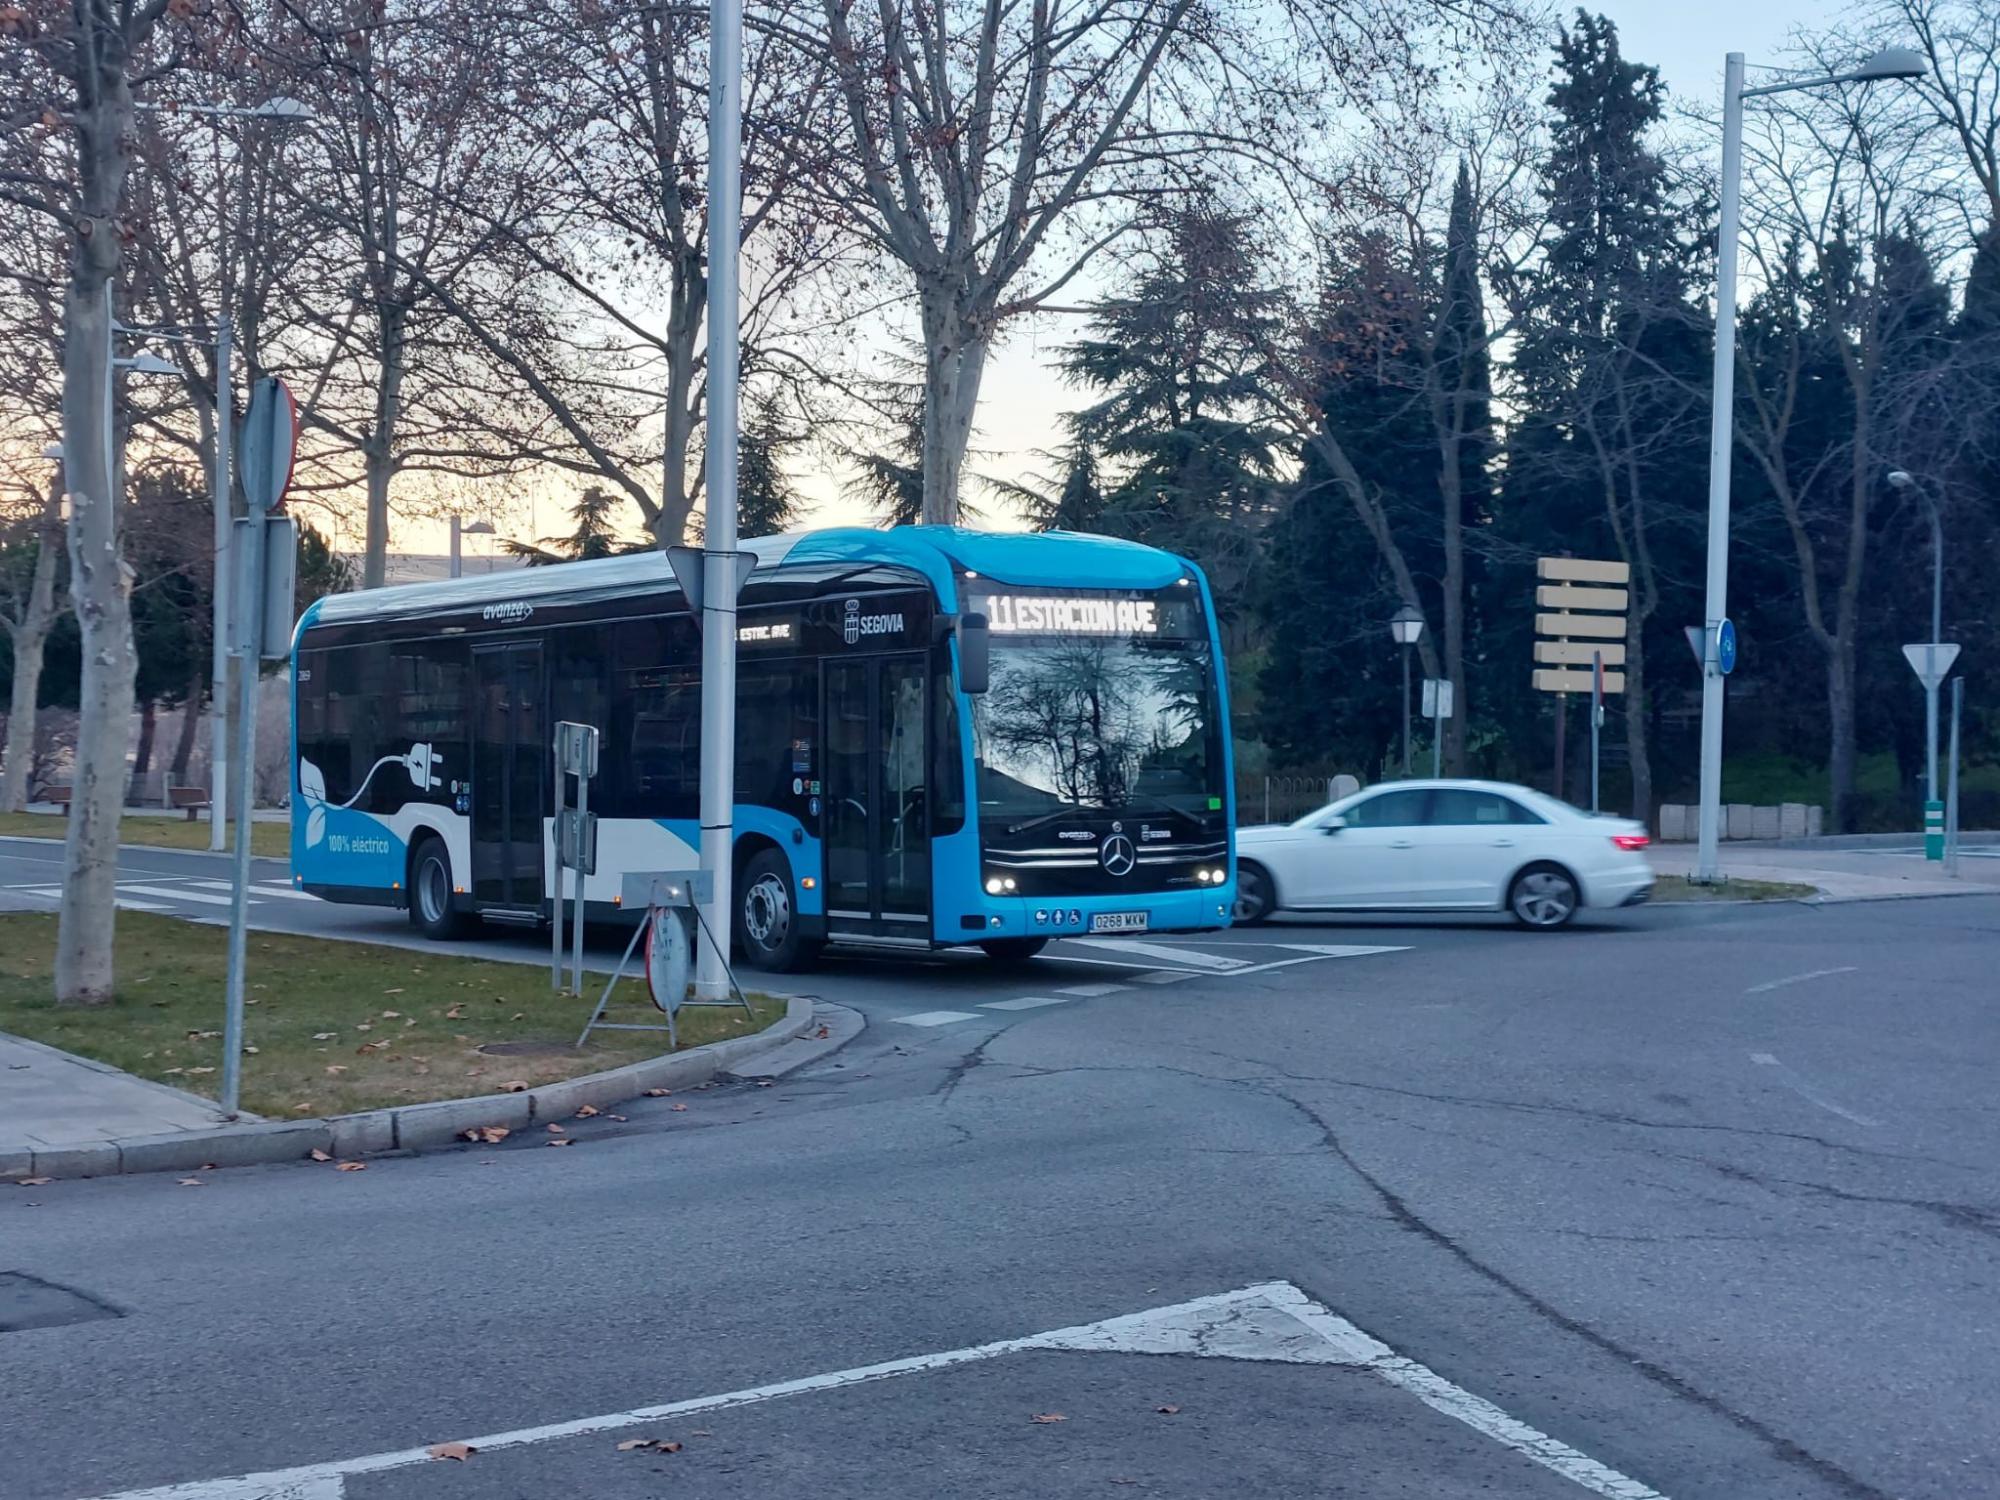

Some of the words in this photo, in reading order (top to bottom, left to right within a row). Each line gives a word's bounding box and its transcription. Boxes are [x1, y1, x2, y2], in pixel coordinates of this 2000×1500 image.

[483, 601, 524, 620] avanza
[986, 595, 1015, 631] 11
[1015, 598, 1117, 632] ESTACION
[1117, 601, 1158, 633] AVE
[860, 613, 904, 635] SEGOVIA
[329, 835, 350, 852] 100%
[352, 835, 389, 854] eléctrico
[1096, 915, 1122, 929] 0268
